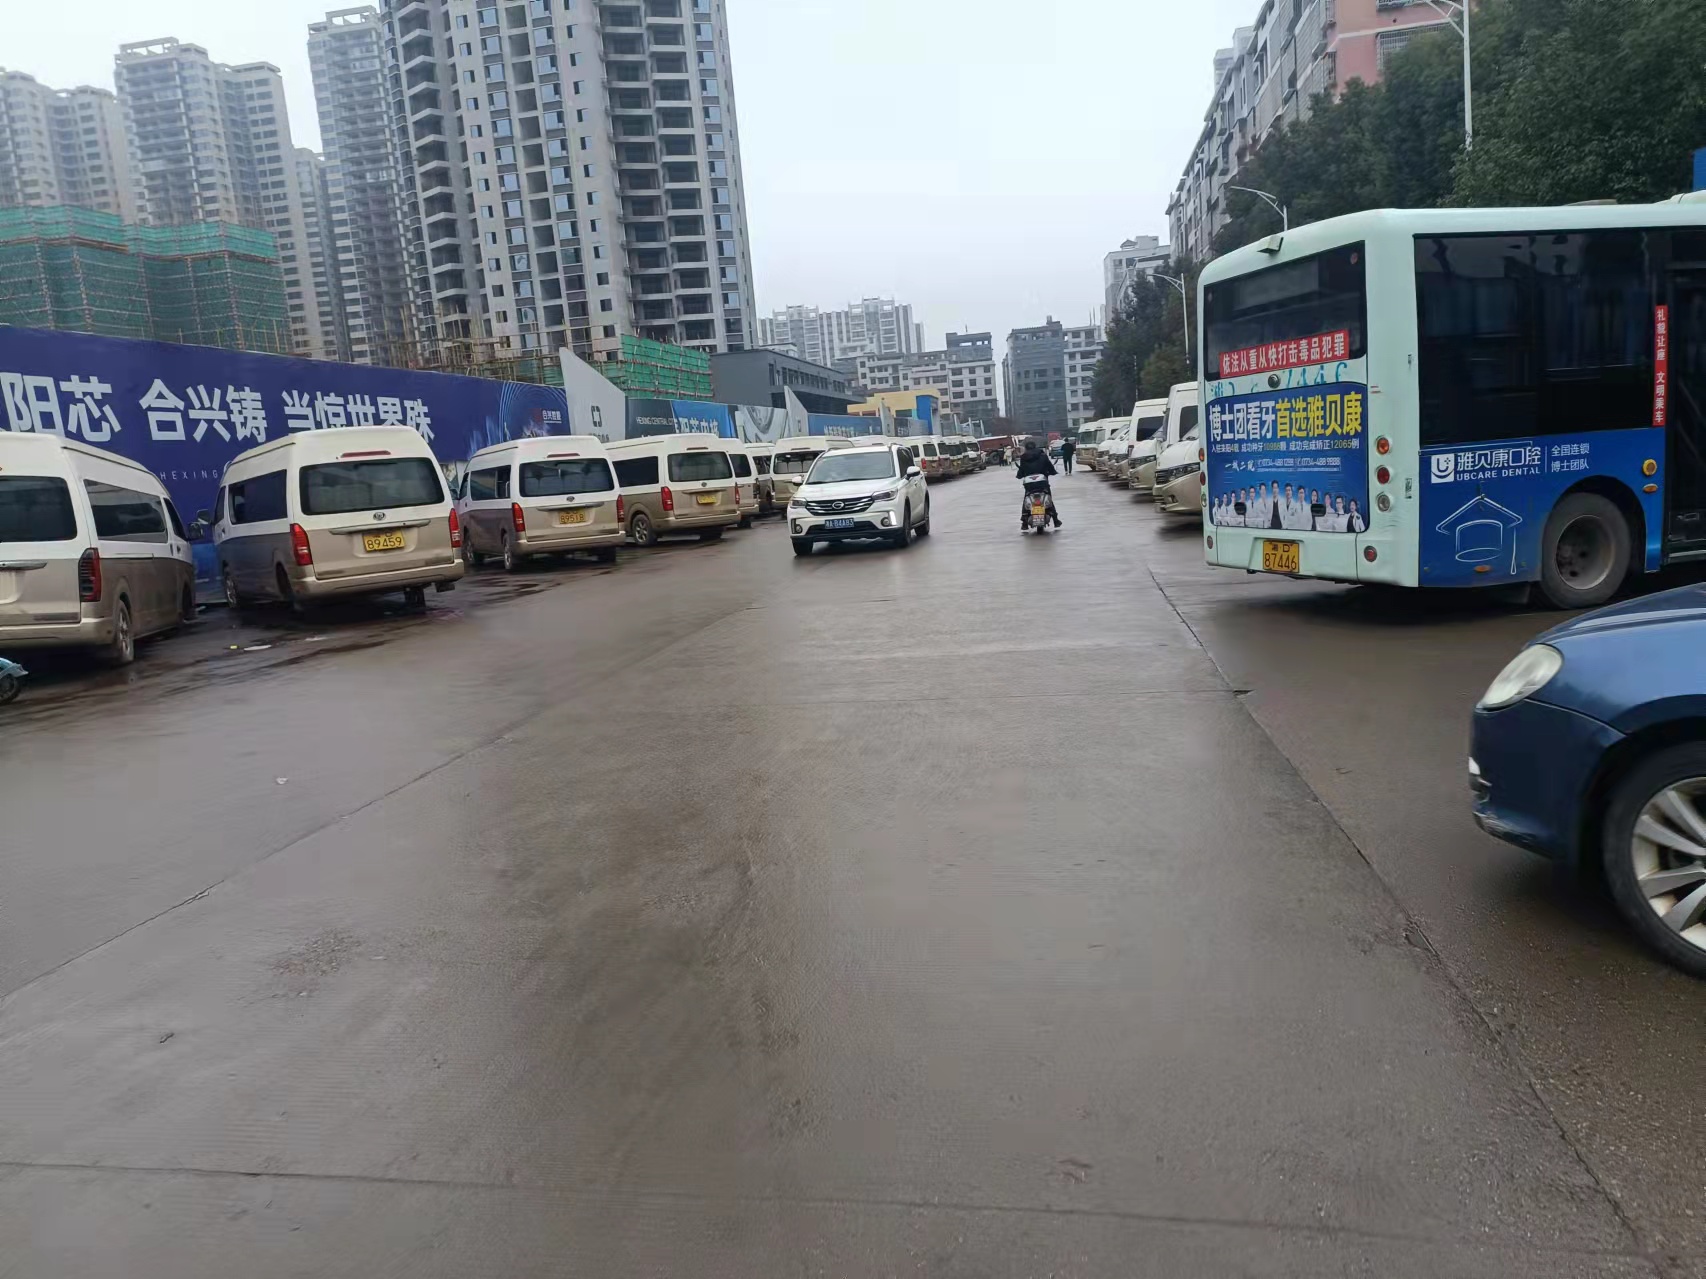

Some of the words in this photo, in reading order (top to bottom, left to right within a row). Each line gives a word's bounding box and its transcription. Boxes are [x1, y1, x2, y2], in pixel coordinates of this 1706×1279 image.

[1223, 332, 1345, 375] 依法从重从快打击毒品犯罪
[1655, 371, 1665, 422] 文明乘车
[139, 378, 268, 443] 合兴铸
[1456, 446, 1541, 471] 雅贝康口腔
[1551, 443, 1590, 457] 全国连锁
[1456, 470, 1498, 481] UBCARE
[1502, 466, 1541, 477] DENTAL
[1551, 458, 1589, 473] 博士团队
[366, 536, 402, 549] 89459
[1265, 552, 1297, 570] 87446
